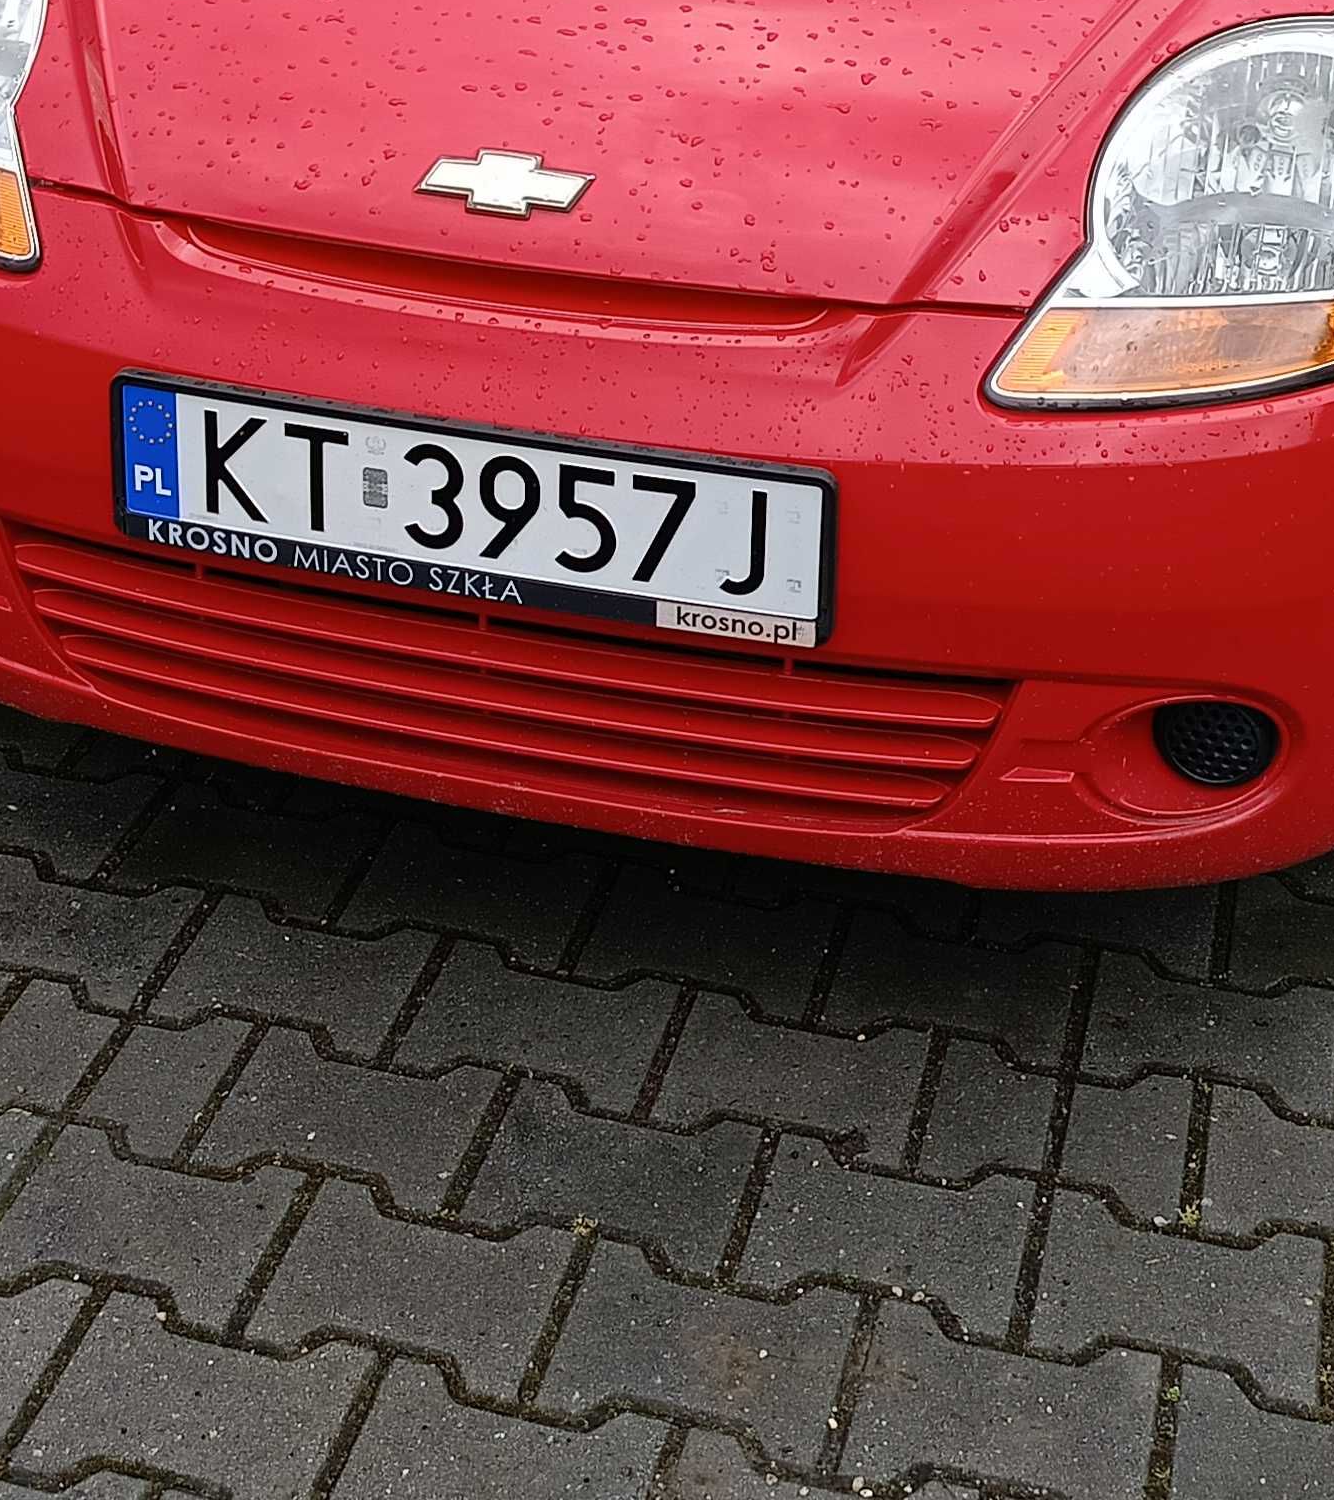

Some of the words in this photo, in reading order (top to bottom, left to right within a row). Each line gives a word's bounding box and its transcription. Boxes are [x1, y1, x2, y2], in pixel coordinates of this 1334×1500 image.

[134, 463, 172, 497] PL
[203, 408, 349, 533] KT
[404, 442, 768, 596] 3957J
[147, 518, 278, 562] KROSNO
[292, 545, 414, 585] MIASTO
[428, 567, 524, 605] SZKŁA
[675, 605, 798, 644] krosno.pl
